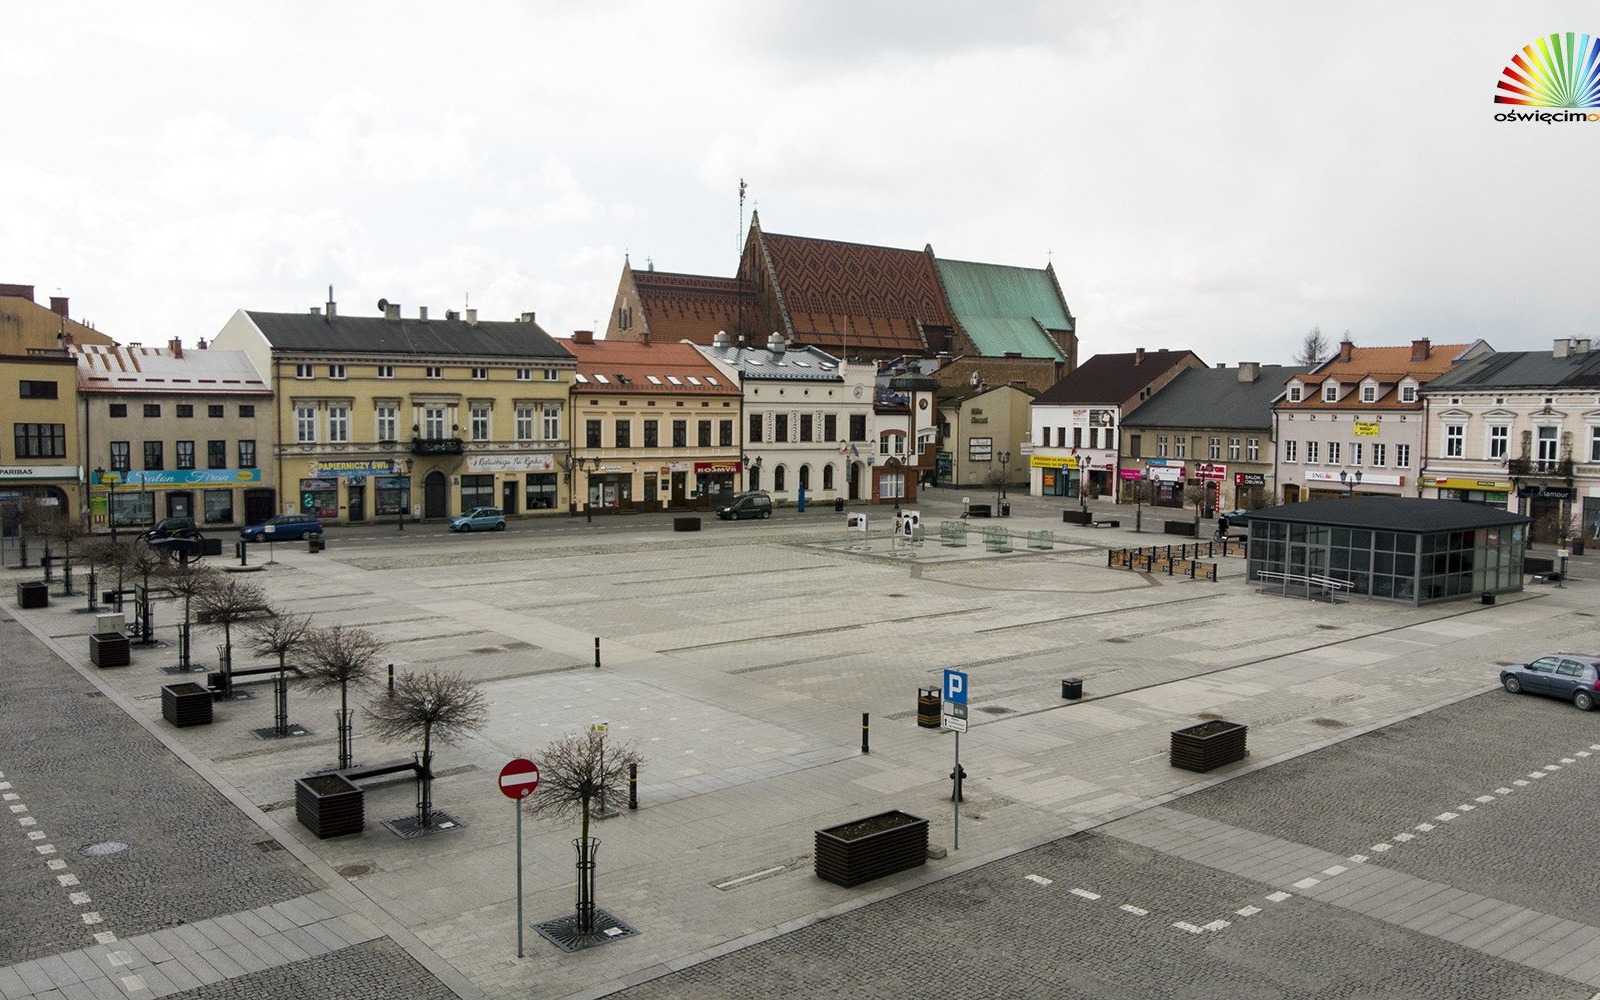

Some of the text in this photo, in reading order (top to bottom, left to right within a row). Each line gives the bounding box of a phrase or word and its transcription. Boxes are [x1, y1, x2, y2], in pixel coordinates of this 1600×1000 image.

[318, 460, 391, 471] PAPIERNICZY ŚWI
[128, 471, 176, 483] Salon
[949, 673, 963, 698] P
